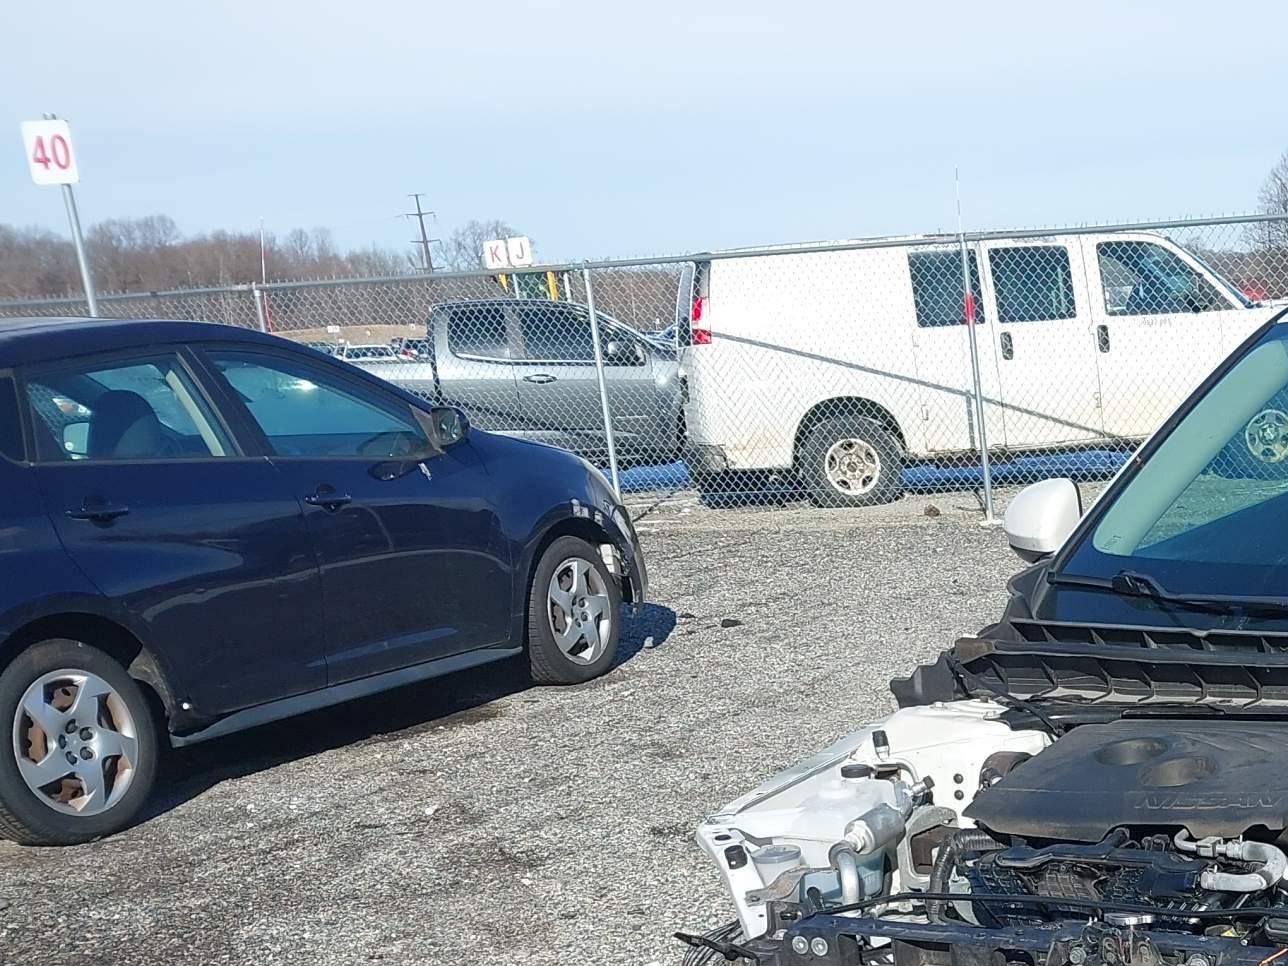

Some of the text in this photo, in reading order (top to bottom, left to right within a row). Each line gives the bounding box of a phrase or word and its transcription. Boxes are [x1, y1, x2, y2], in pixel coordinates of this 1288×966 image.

[31, 134, 71, 170] 40
[489, 245, 502, 263] K
[515, 241, 525, 260] J
